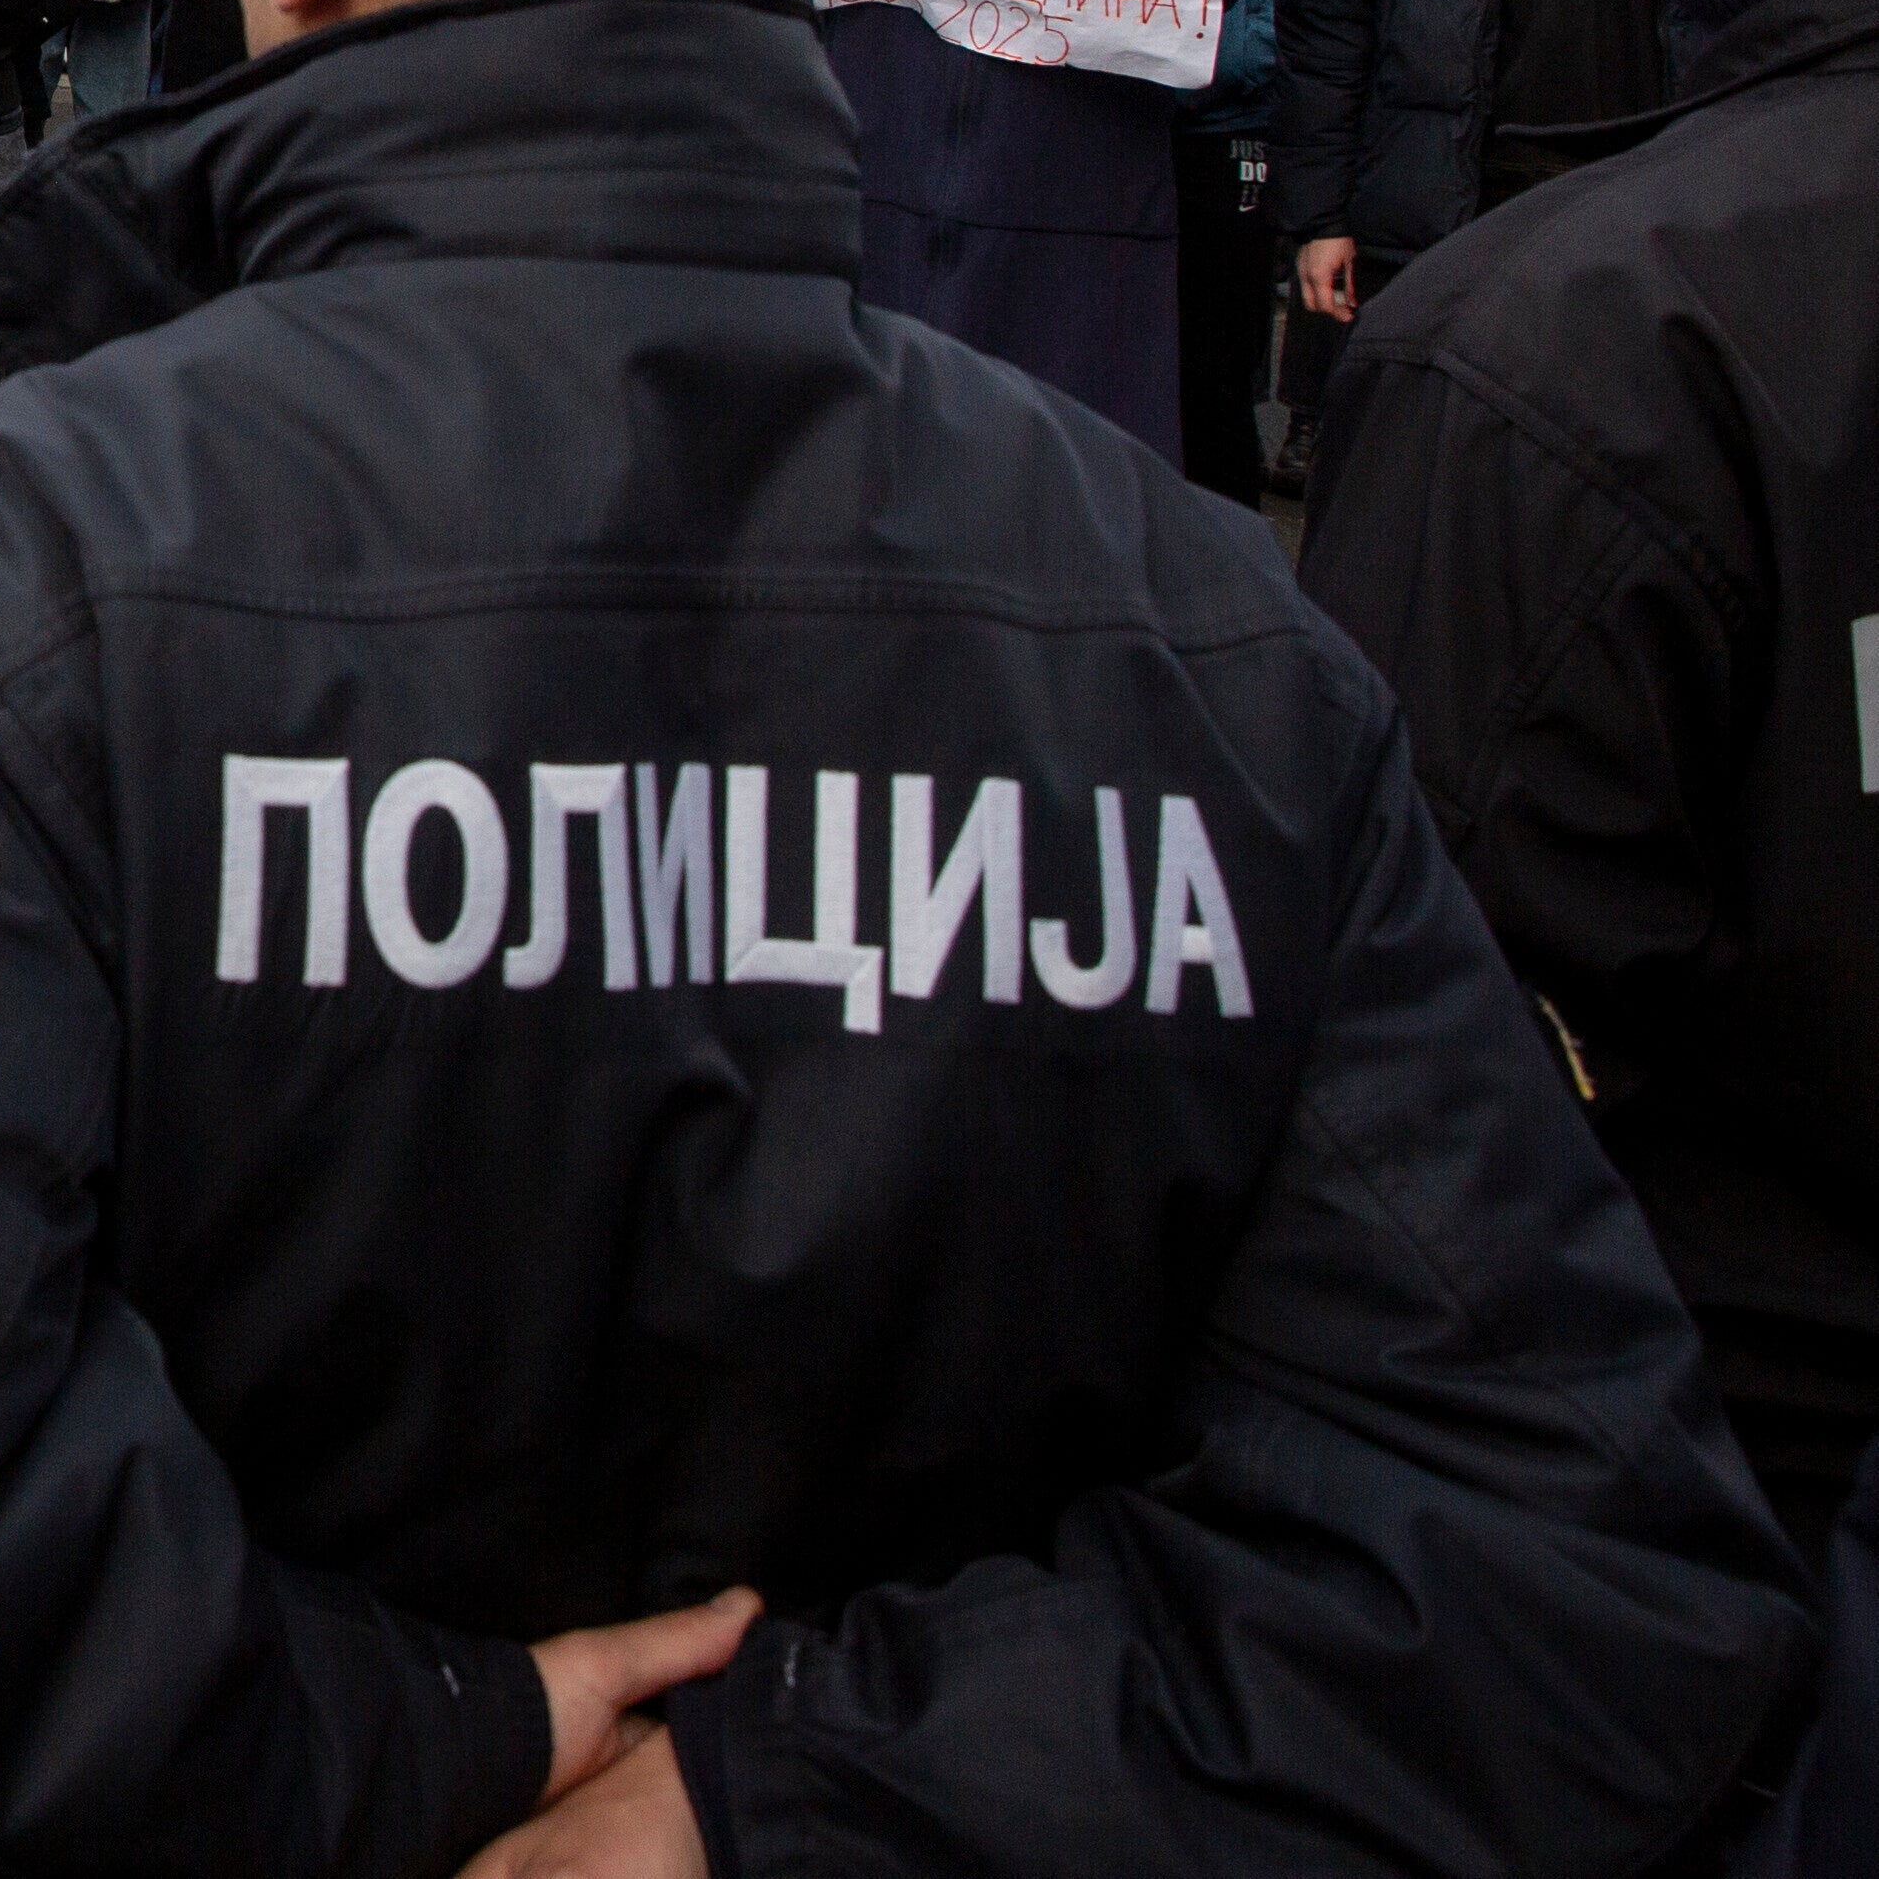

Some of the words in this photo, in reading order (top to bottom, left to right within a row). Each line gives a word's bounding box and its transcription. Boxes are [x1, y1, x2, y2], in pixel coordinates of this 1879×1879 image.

[1229, 139, 1266, 160] JUS
[1240, 161, 1267, 182] DO
[217, 753, 1255, 1034] ПОЛИЦИЈА
